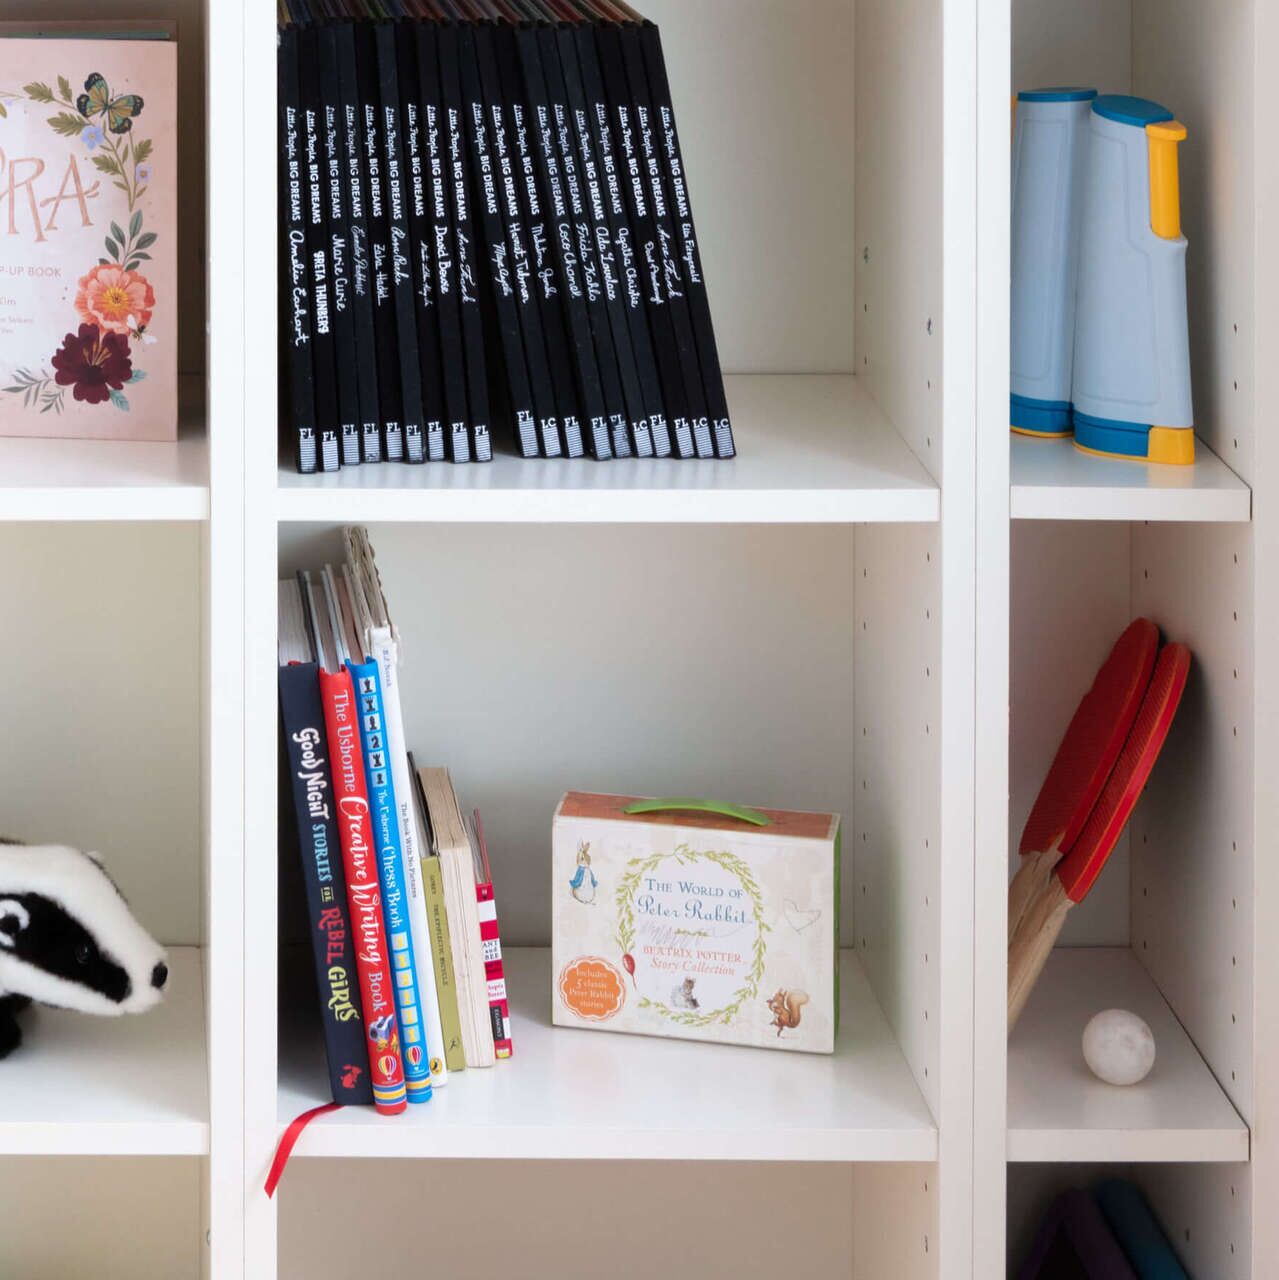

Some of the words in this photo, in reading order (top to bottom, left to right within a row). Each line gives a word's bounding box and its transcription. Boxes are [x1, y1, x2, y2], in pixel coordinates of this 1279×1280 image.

[290, 162, 300, 178] BIG
[290, 180, 301, 220] DREAMS
[331, 234, 346, 275] Marie
[334, 278, 348, 312] Curie
[332, 690, 350, 722] The
[335, 725, 357, 792] Usborne
[338, 796, 369, 880] Creative
[638, 895, 680, 917] Peter
[685, 900, 745, 923] Rabbit
[678, 881, 724, 897] WORLD
[349, 881, 383, 967] Writing
[367, 972, 384, 1012] Book
